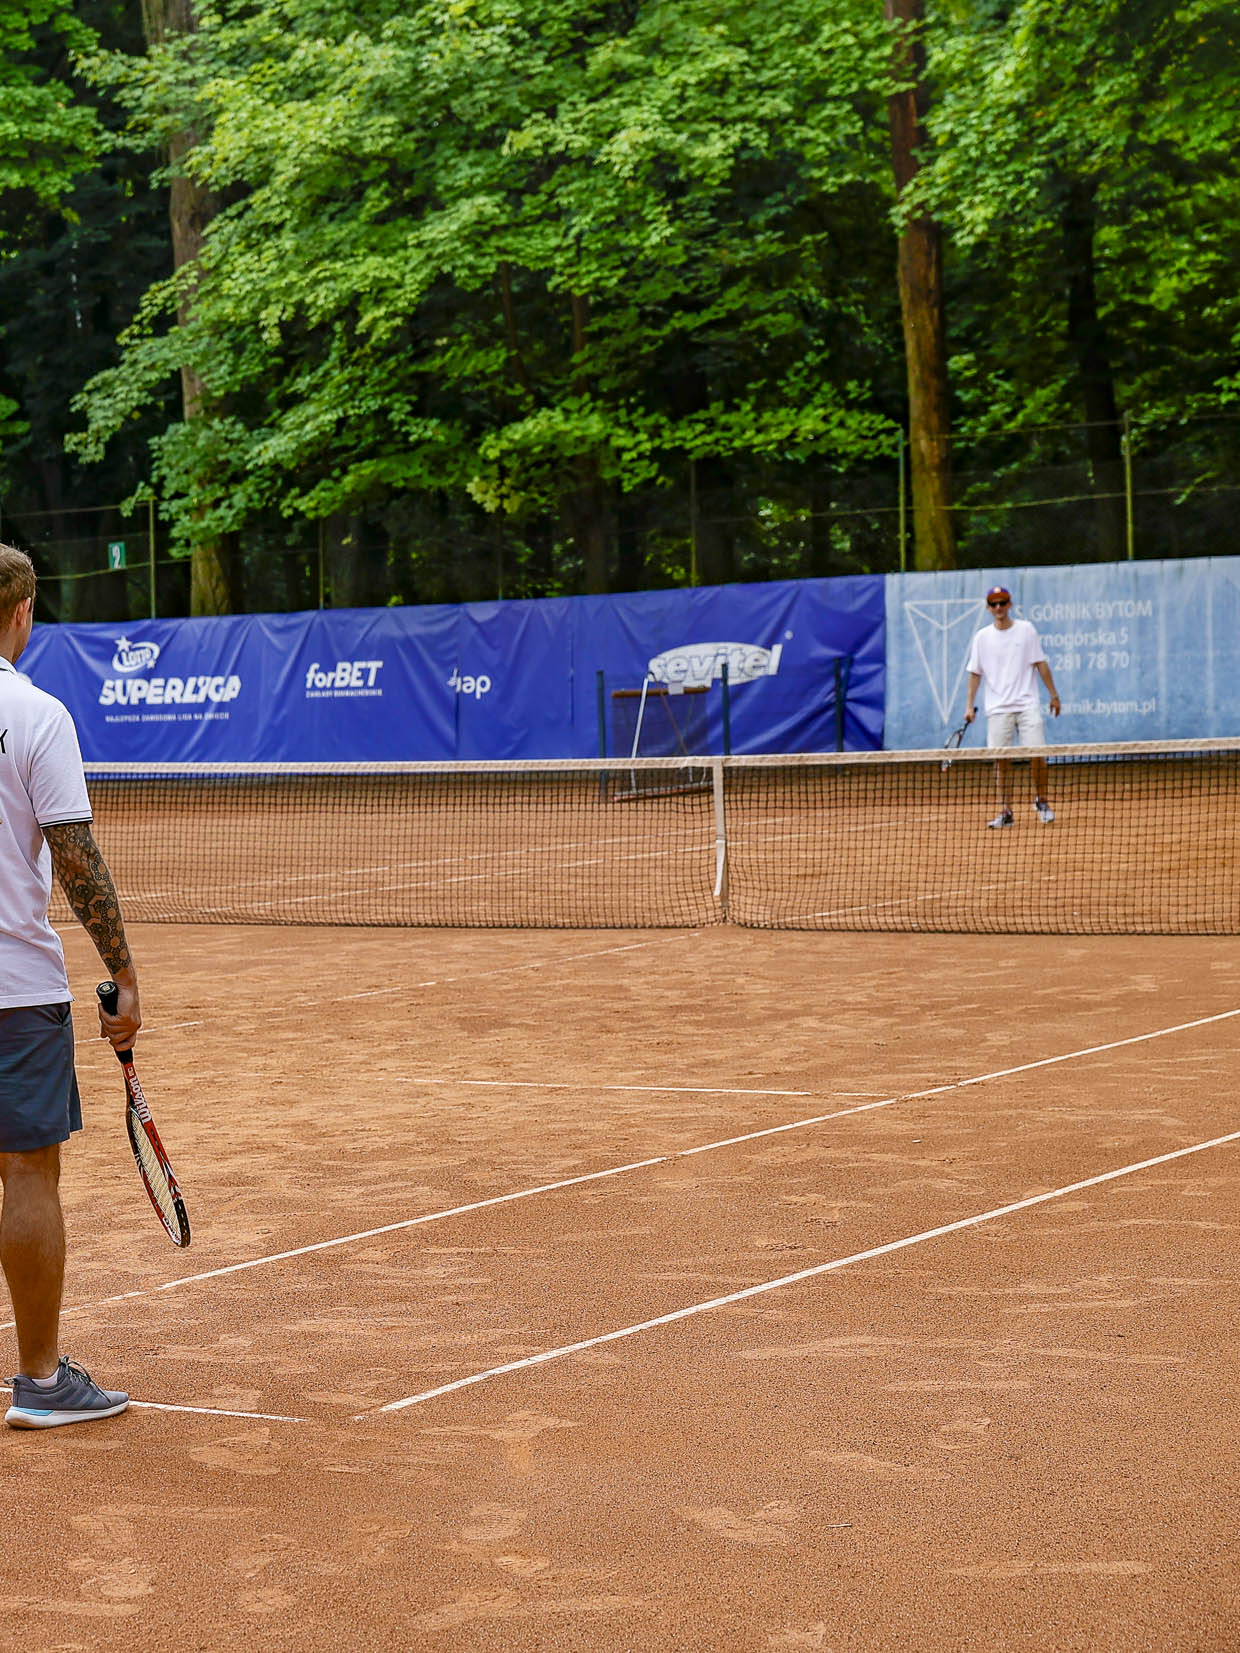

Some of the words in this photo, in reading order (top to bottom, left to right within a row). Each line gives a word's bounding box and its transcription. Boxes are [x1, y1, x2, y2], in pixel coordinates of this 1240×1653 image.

[1030, 602, 1091, 622] GÓRNIK
[1095, 600, 1153, 619] BYTOM
[1120, 626, 1129, 645] 5
[1054, 653, 1081, 671] 281
[1087, 651, 1108, 669] 78
[1111, 650, 1130, 668] 70
[305, 661, 383, 688] forBET
[129, 1076, 153, 1124] Wilson
